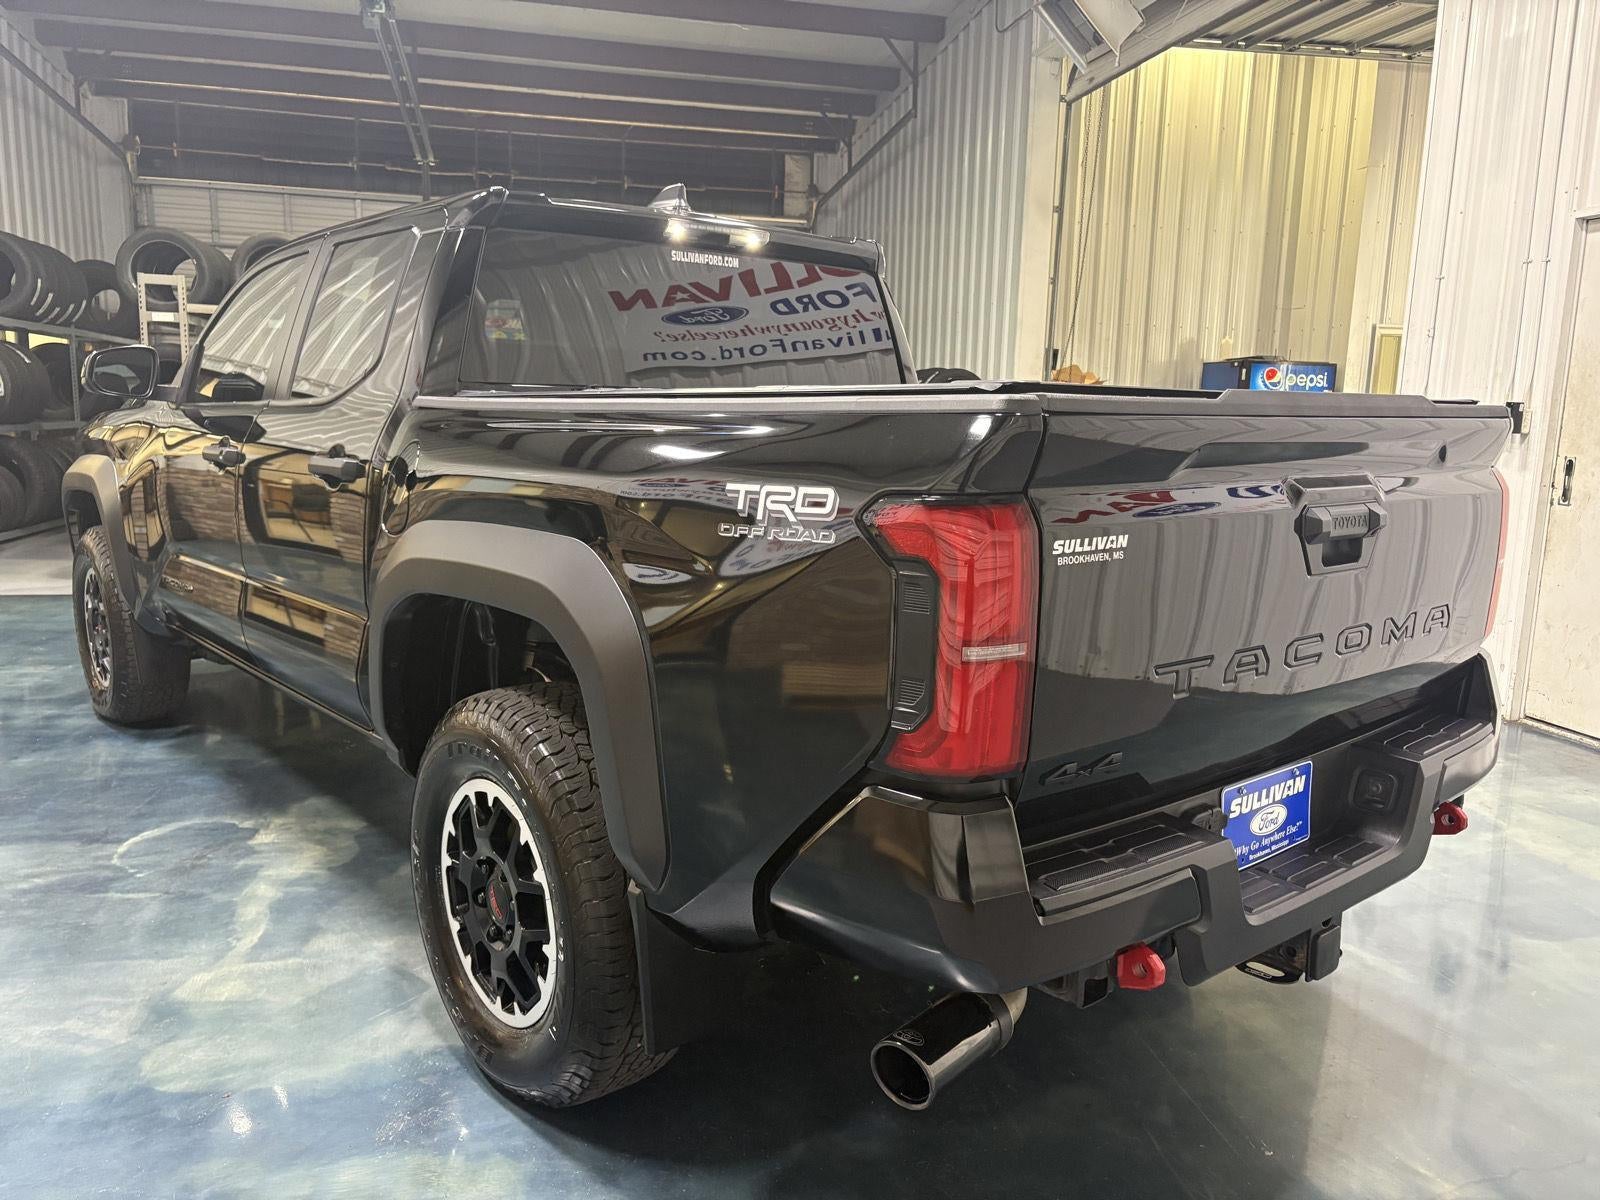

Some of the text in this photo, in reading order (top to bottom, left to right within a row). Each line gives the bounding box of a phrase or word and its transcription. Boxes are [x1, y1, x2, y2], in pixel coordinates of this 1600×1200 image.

[671, 250, 739, 268] SULLIVANFORD.COM
[1285, 372, 1328, 391] pepsi
[725, 482, 840, 527] TRD
[1332, 514, 1368, 530] TOYOTA
[718, 523, 837, 544] OFF ROAD
[1052, 534, 1129, 555] SULLIVAN
[1057, 550, 1124, 566] BROOKHAVEN, MS
[1153, 603, 1452, 700] TACOMA
[1229, 774, 1307, 819] SULLIVAN
[1258, 810, 1281, 832] Ford
[1250, 840, 1260, 851] Go
